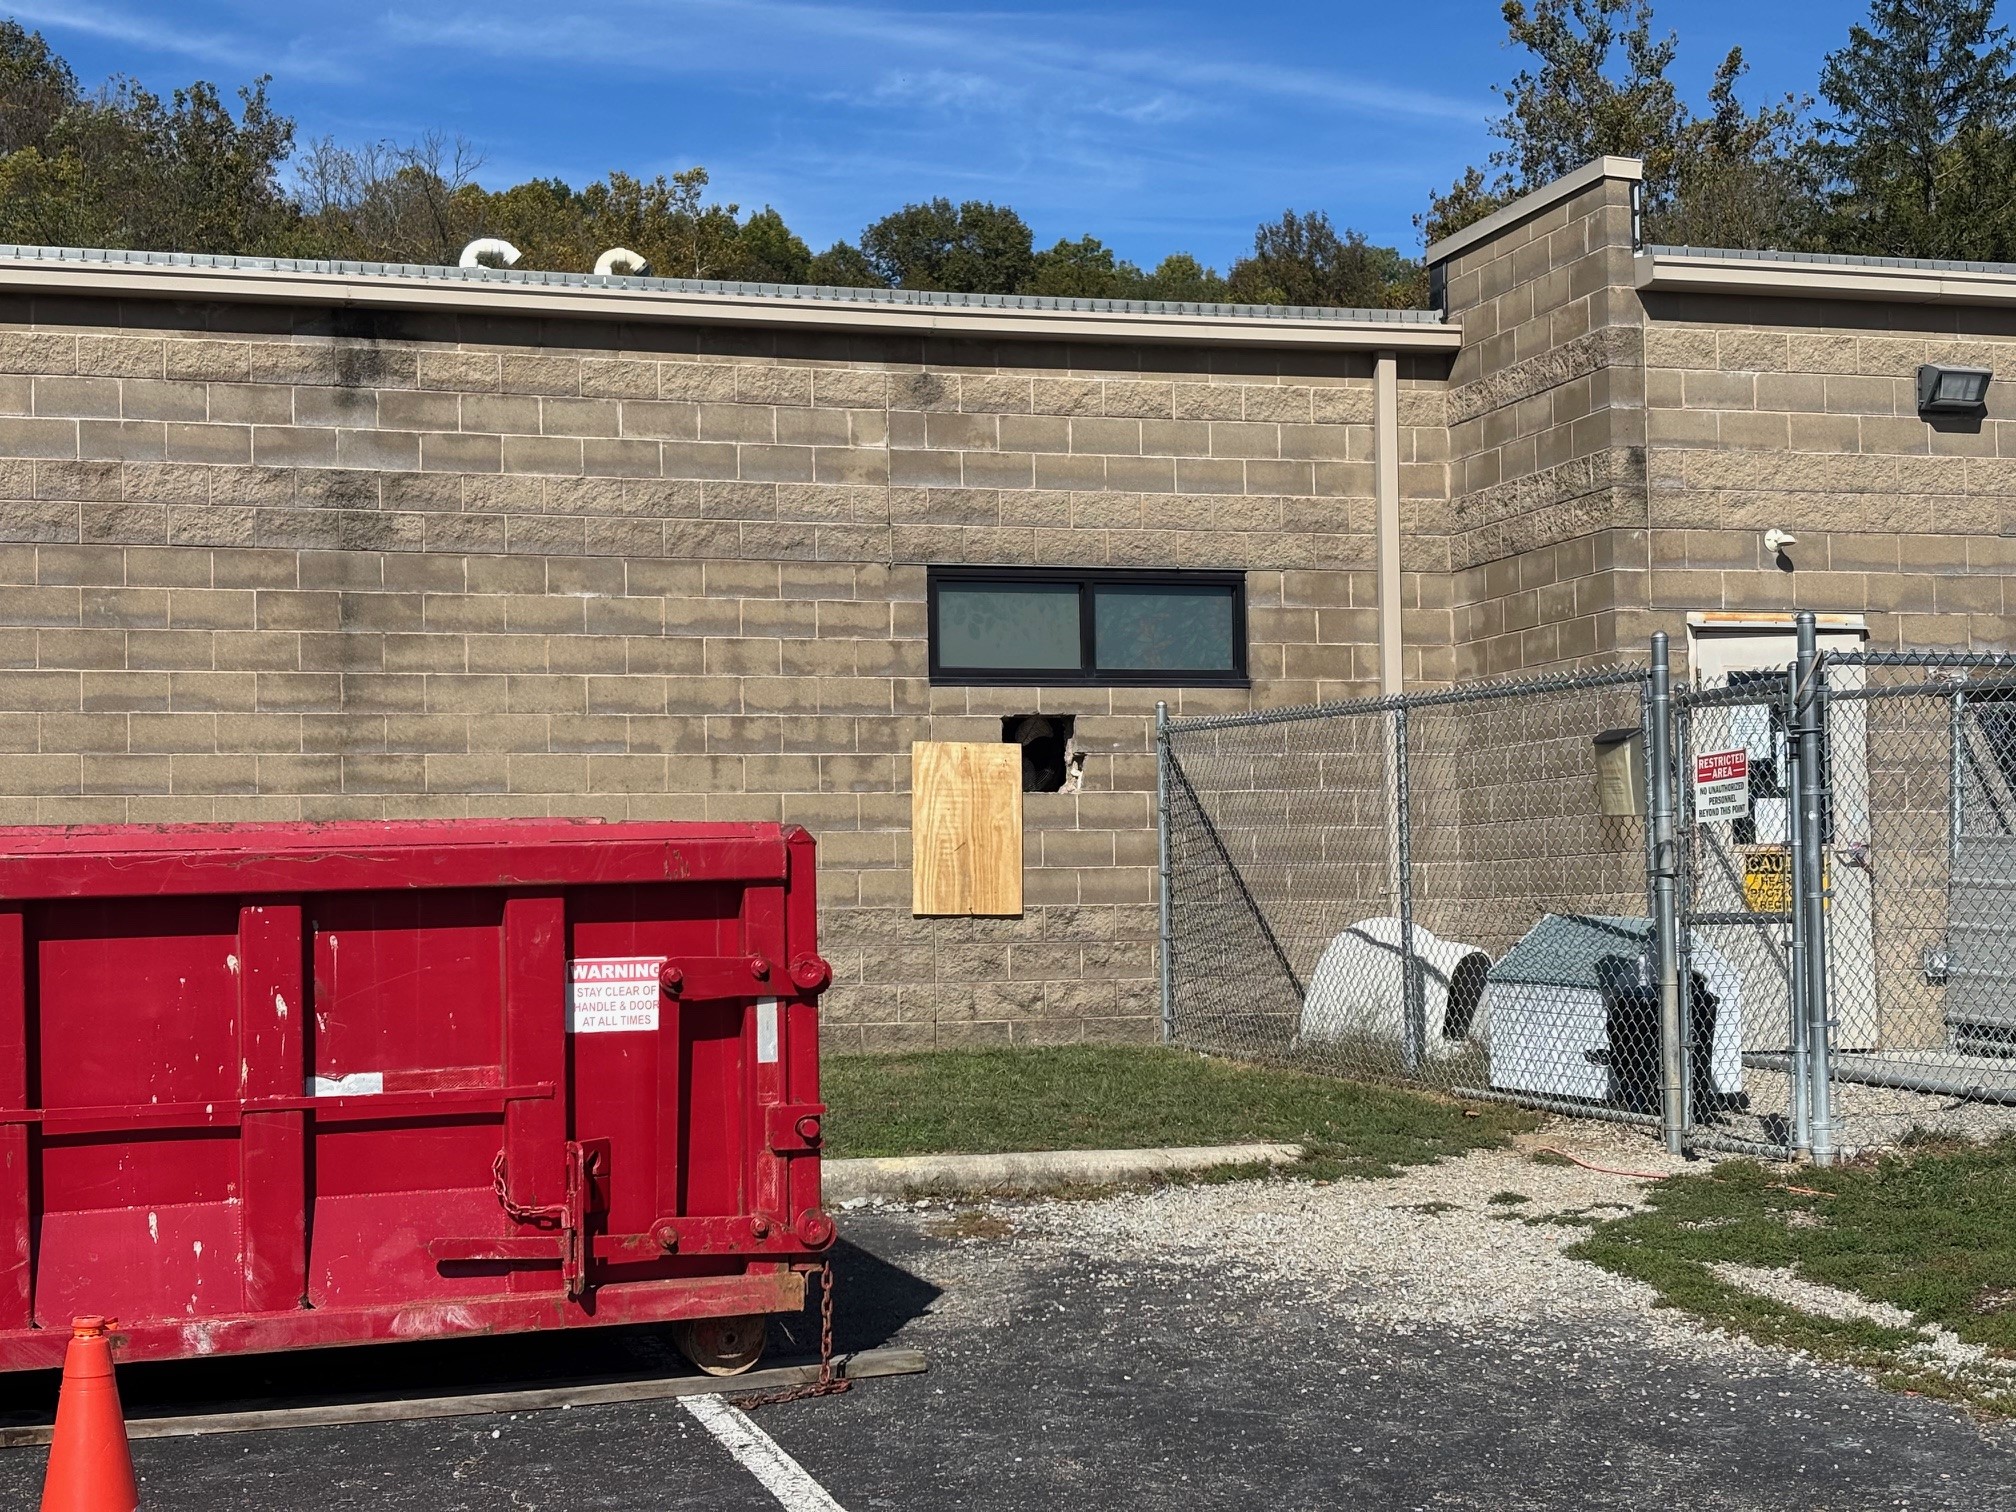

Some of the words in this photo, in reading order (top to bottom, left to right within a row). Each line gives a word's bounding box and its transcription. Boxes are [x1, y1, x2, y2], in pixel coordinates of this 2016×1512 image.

[1698, 753, 1745, 770] RESTRICTED
[1712, 766, 1733, 779] AREA
[1700, 786, 1707, 795] NO
[1708, 782, 1744, 794] UNAUTHORIZED
[1709, 794, 1736, 805] PERSONNEL
[1699, 808, 1719, 818] BEYOND
[1720, 806, 1731, 815] THIS
[1732, 804, 1745, 814] POINT
[570, 962, 660, 979] WARNING
[577, 988, 602, 998] STAY
[606, 986, 640, 996] CLEAR
[643, 986, 656, 996] OF
[574, 1002, 616, 1012] HANDLE
[620, 1001, 626, 1011] &
[582, 1016, 596, 1026] AT
[598, 1016, 617, 1026] ALL
[621, 1015, 651, 1025] TIMES
